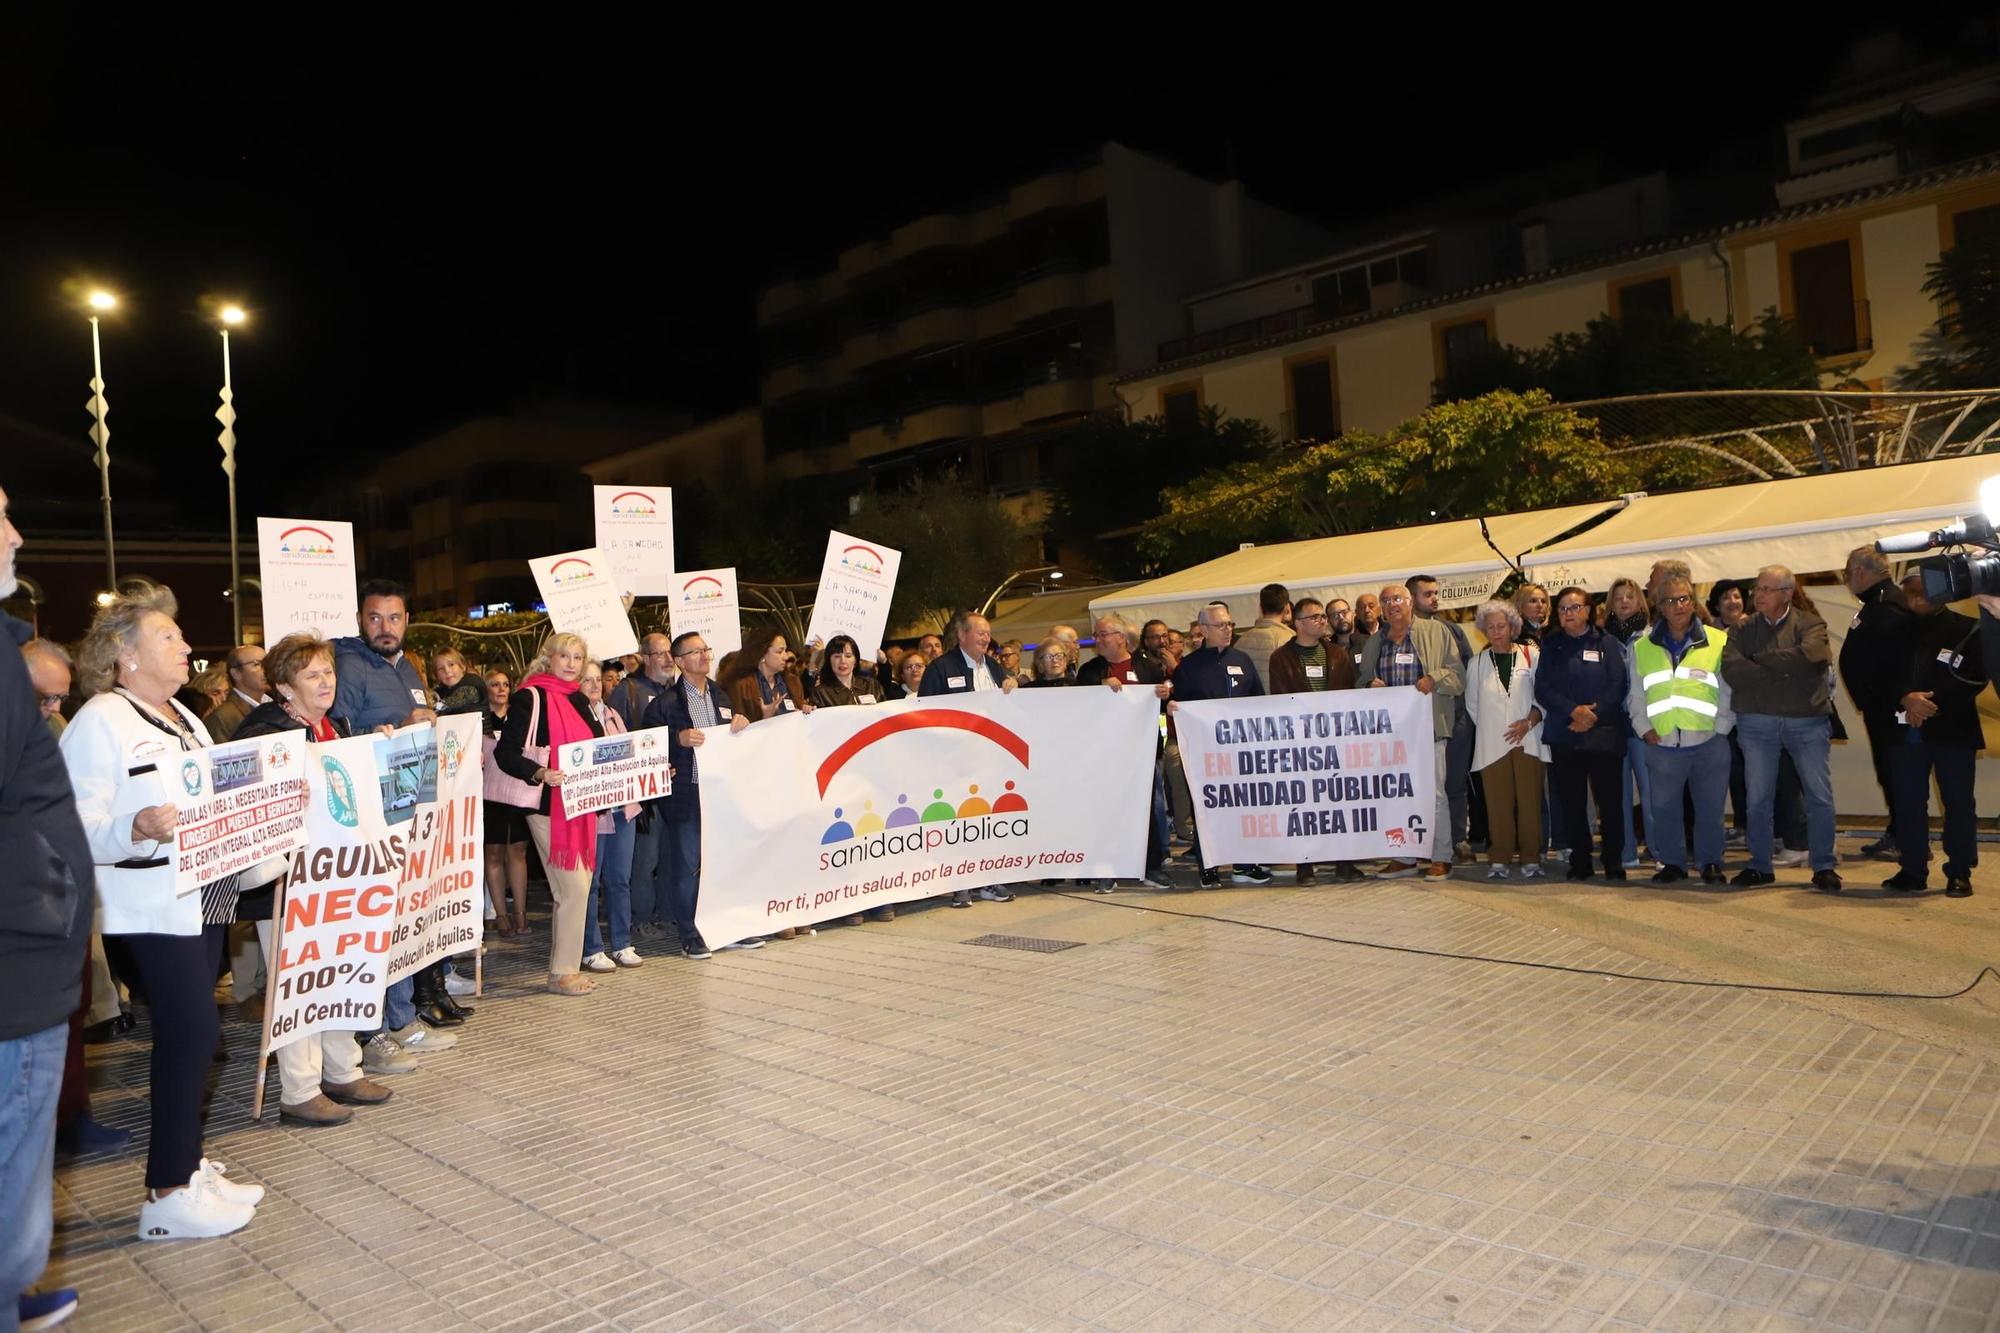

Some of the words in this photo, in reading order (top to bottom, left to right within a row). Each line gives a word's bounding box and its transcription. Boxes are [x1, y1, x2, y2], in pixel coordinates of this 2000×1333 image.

[1442, 583, 1488, 599] COLUMNAS
[1541, 577, 1587, 589] TRELLA
[1215, 715, 1295, 745] GANAR
[1300, 709, 1392, 738] TOTANA
[601, 764, 612, 775] Alta
[1204, 751, 1233, 777] EN
[1238, 745, 1340, 775] DEFENSA
[1344, 743, 1374, 769] DE
[1379, 740, 1408, 767] LA
[235, 787, 270, 808] NECESITAN
[270, 783, 278, 798] DE
[577, 791, 624, 811] SERVICIO
[638, 772, 657, 797] YA
[601, 779, 624, 792] Servicios
[1203, 779, 1306, 809] SANIDAD
[1312, 772, 1414, 803] PÚBLICA
[256, 805, 267, 823] EN
[267, 796, 301, 819] SERVICIO
[422, 811, 433, 840] 3
[1240, 812, 1281, 838] DEL
[1287, 807, 1347, 837] ÁREA
[1351, 807, 1377, 833] III
[180, 853, 194, 872] DEL
[221, 832, 252, 857] INTEGRAL
[253, 827, 267, 845] ALTA
[220, 853, 250, 873] Cartera
[252, 848, 261, 860] de
[262, 837, 295, 856] Servicios
[819, 817, 1029, 872] sanidadpública
[767, 899, 794, 916] Por
[795, 894, 810, 911] ti,
[814, 889, 840, 909] por
[843, 883, 861, 898] tu
[862, 872, 908, 895] salud,
[912, 867, 937, 887] por
[939, 862, 953, 878] la
[956, 859, 976, 875] de
[979, 854, 1023, 871] todas
[1024, 855, 1036, 869] y
[1038, 849, 1084, 864] todos
[279, 940, 320, 971] LA
[336, 930, 391, 956] PU
[409, 870, 474, 912] SERVICIO
[284, 884, 394, 933] NEC
[280, 962, 375, 1000] 100%
[392, 923, 409, 946] de
[413, 899, 471, 937] Servicios
[271, 1009, 299, 1038] del
[304, 998, 376, 1025] Centro
[426, 936, 435, 956] de
